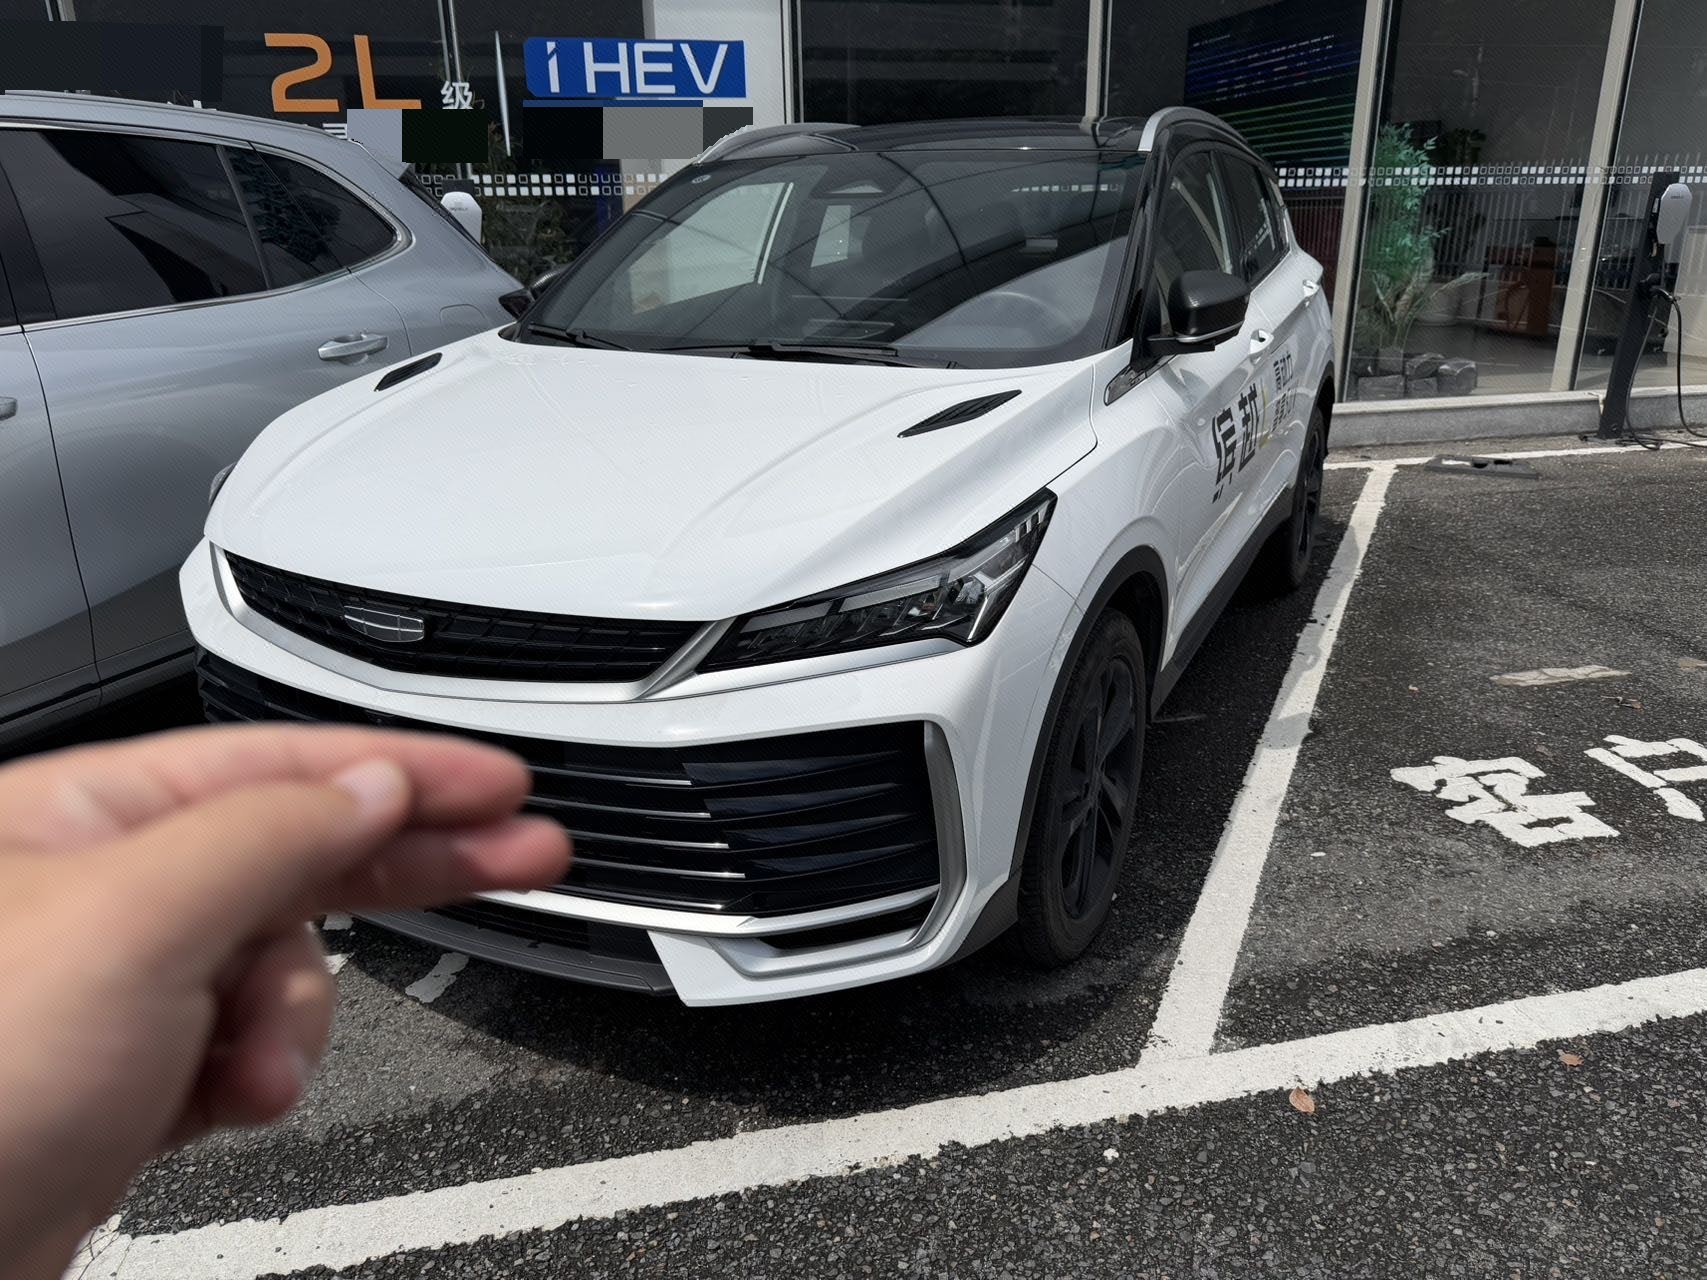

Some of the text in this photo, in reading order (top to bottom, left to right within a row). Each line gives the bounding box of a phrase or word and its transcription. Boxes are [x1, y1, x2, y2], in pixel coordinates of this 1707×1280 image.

[264, 33, 474, 112] 2L 级
[583, 41, 729, 94] HEV
